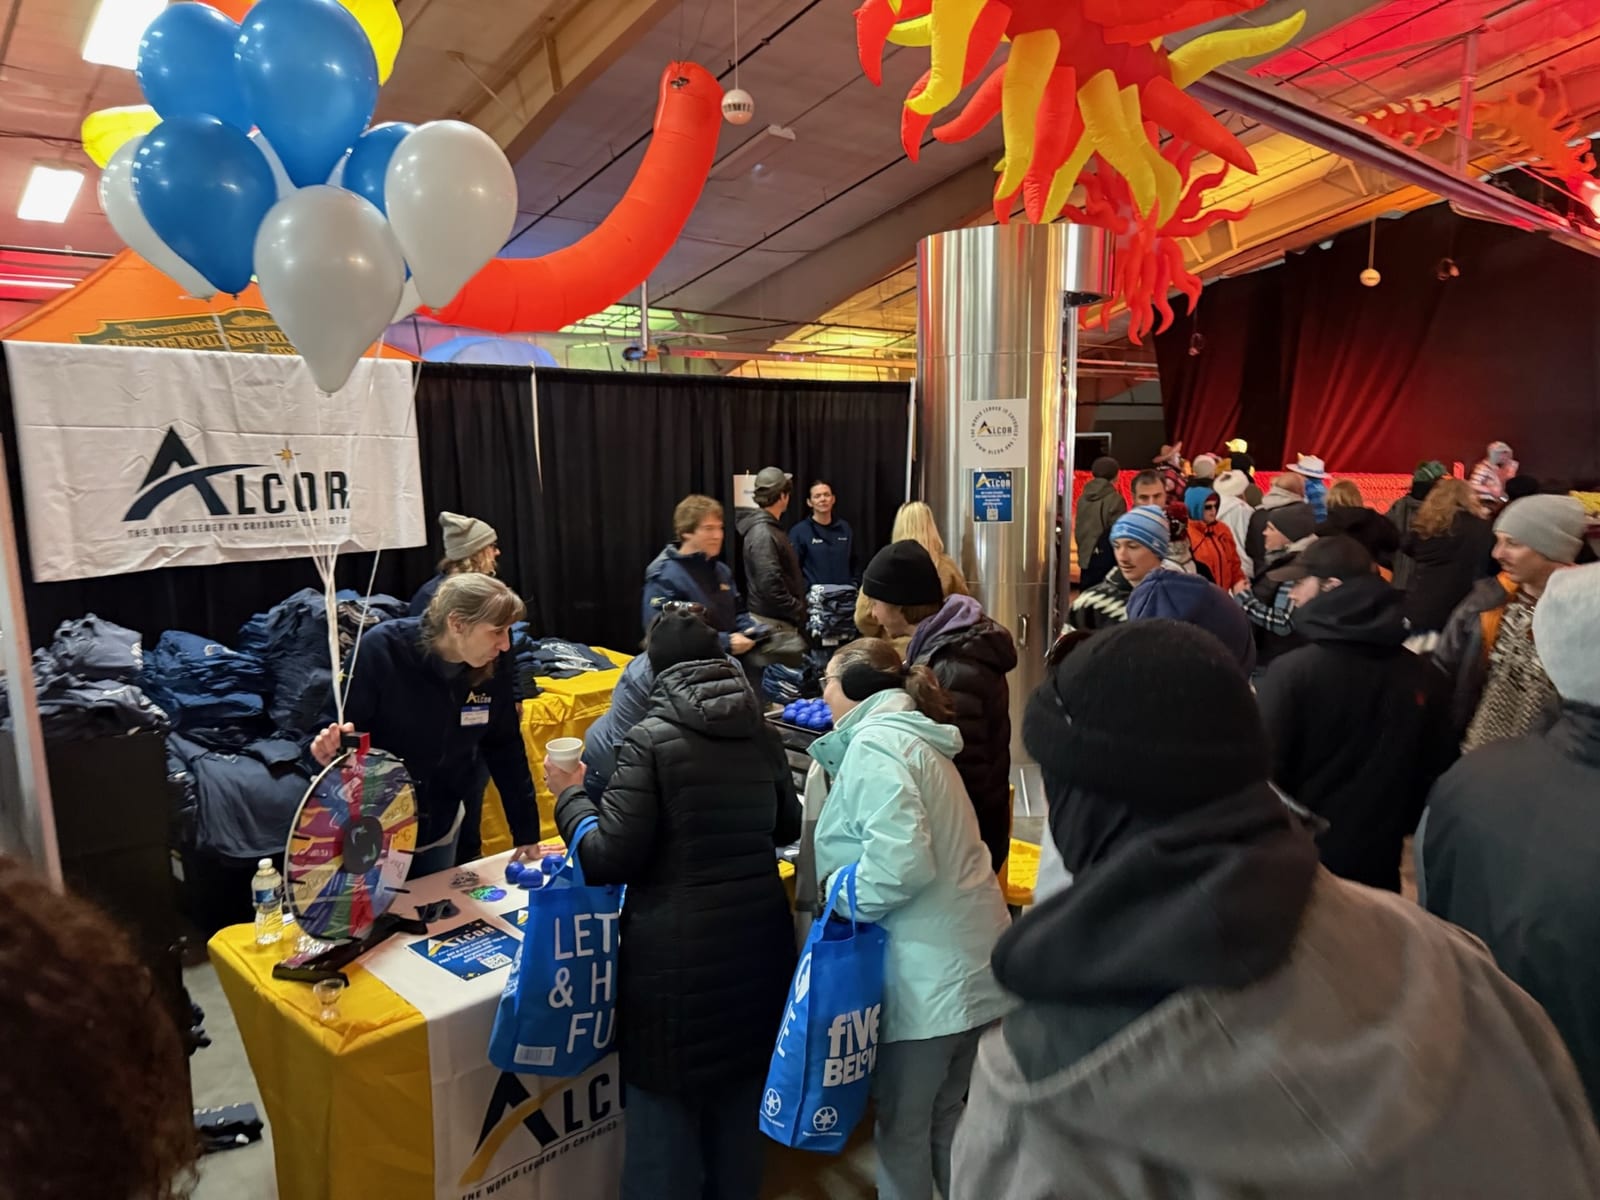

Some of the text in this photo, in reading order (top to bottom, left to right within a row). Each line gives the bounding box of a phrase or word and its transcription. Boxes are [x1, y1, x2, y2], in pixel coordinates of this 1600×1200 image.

[977, 420, 1012, 435] ALCOR
[122, 426, 350, 521] ALCOR
[976, 473, 1011, 488] ALCOR
[428, 925, 496, 956] ALCOR
[554, 912, 620, 960] LET
[548, 967, 574, 1008] &
[486, 1170, 519, 1196] WORLD
[522, 1152, 557, 1175] LEADER
[560, 1143, 571, 1155] IN
[573, 1120, 618, 1148] CRYONICS
